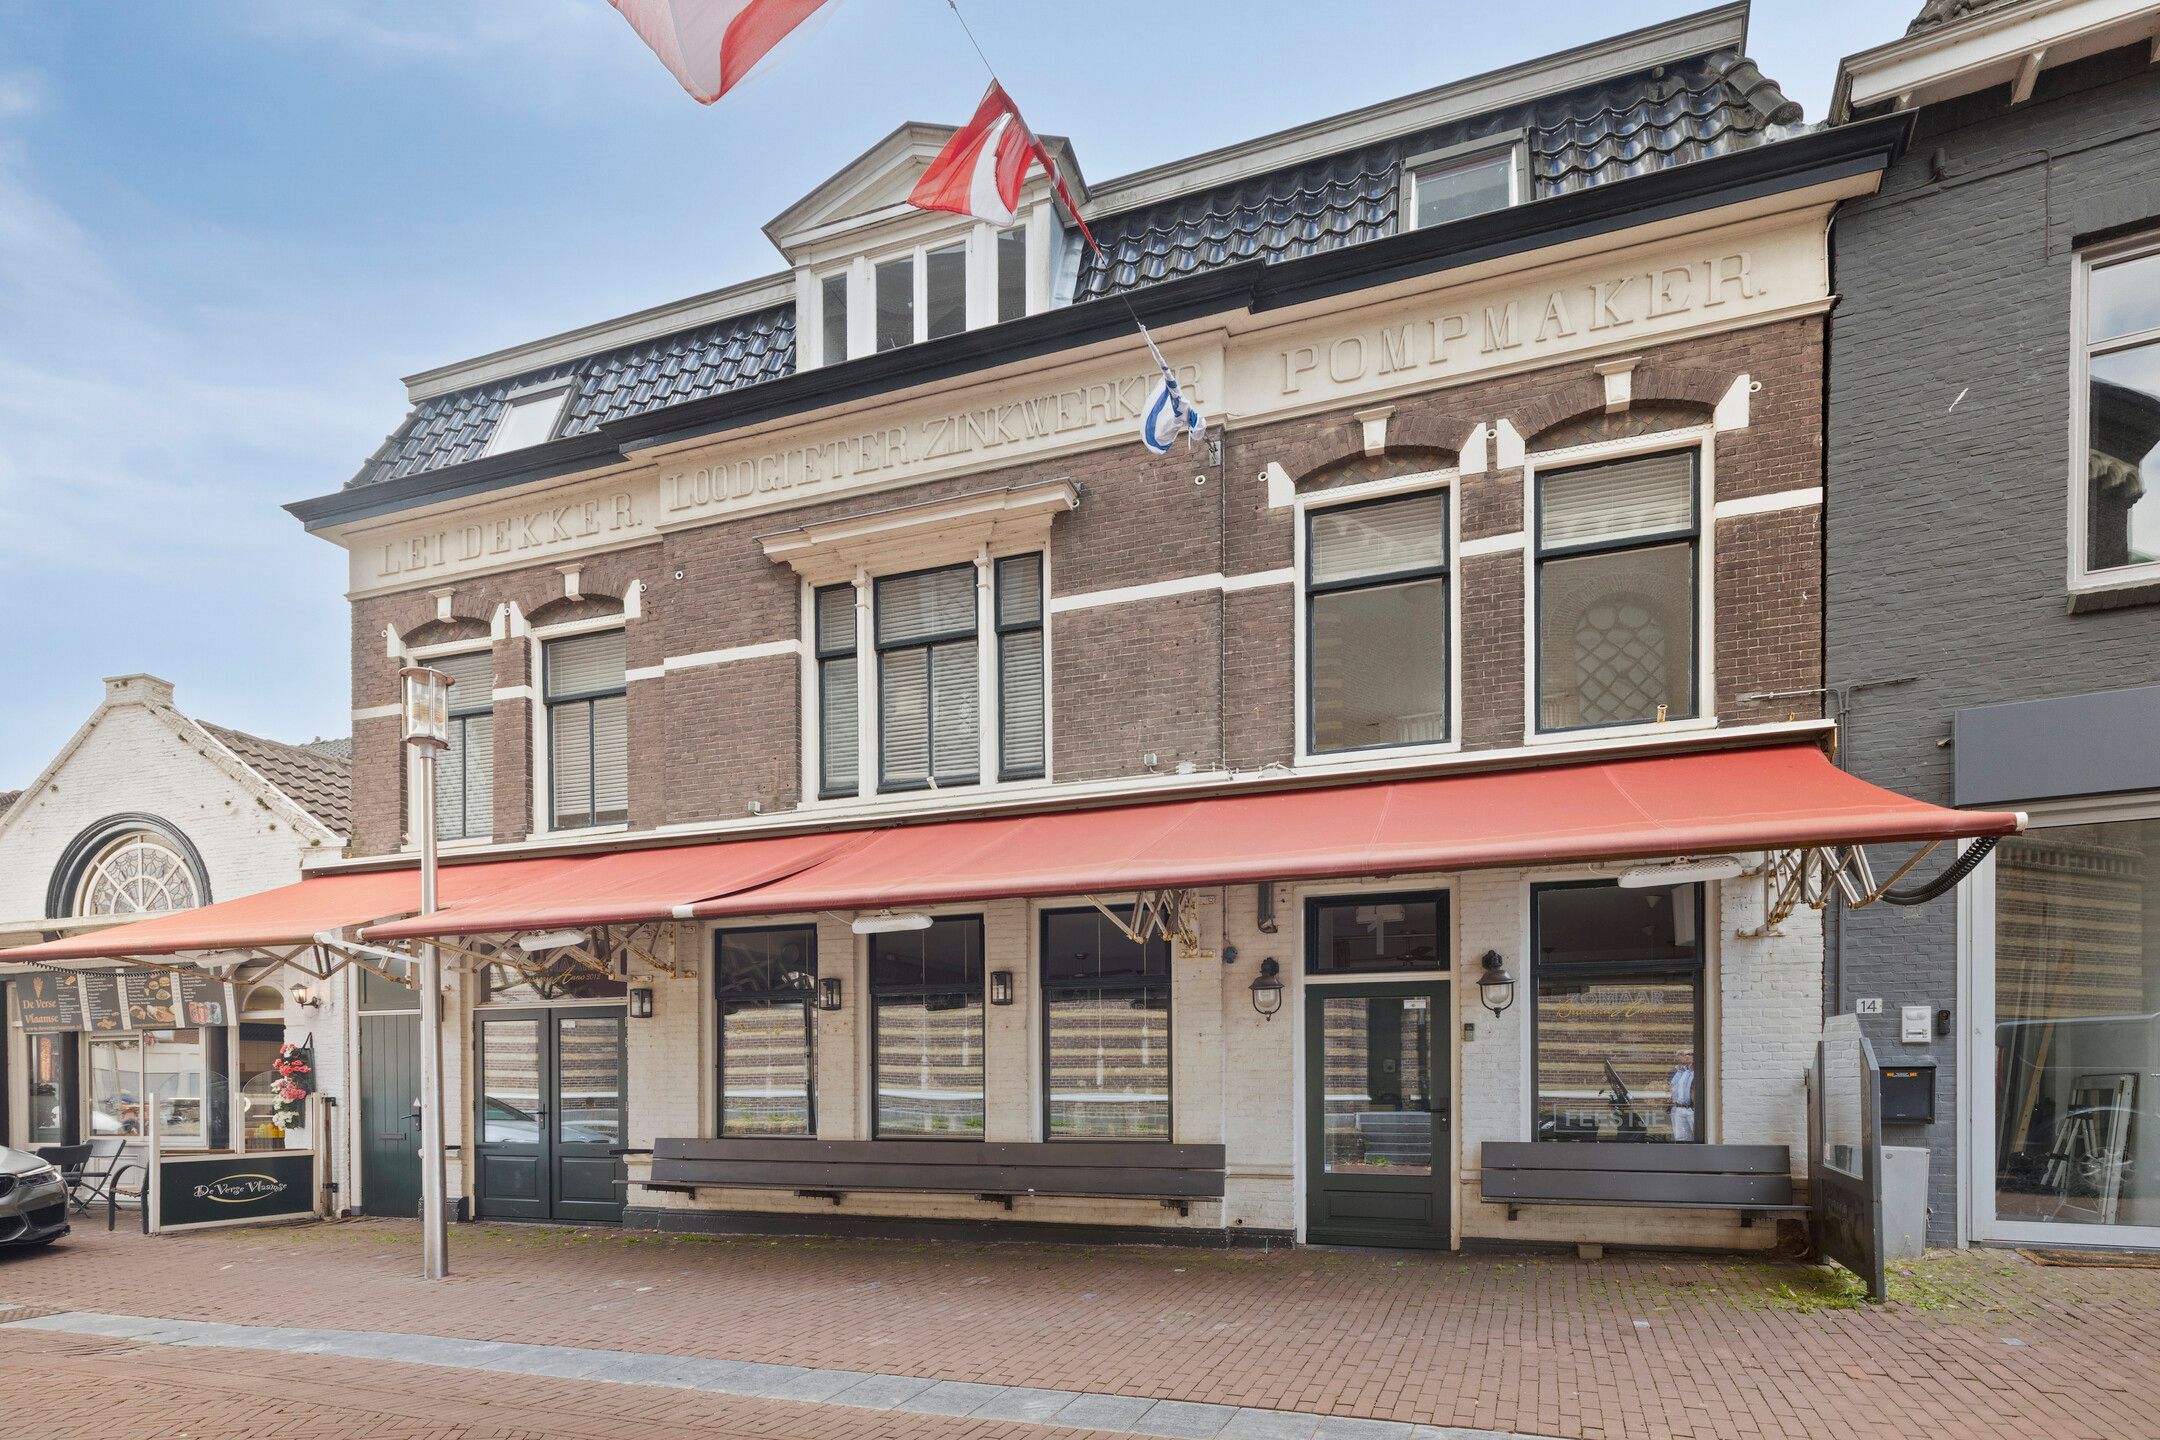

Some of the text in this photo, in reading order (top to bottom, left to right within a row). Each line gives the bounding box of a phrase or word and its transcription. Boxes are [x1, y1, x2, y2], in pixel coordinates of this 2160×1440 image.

[23, 999, 57, 1009] De Verse
[1860, 1000, 1877, 1013] 14
[193, 1180, 287, 1198] De Verse Vlaamse
